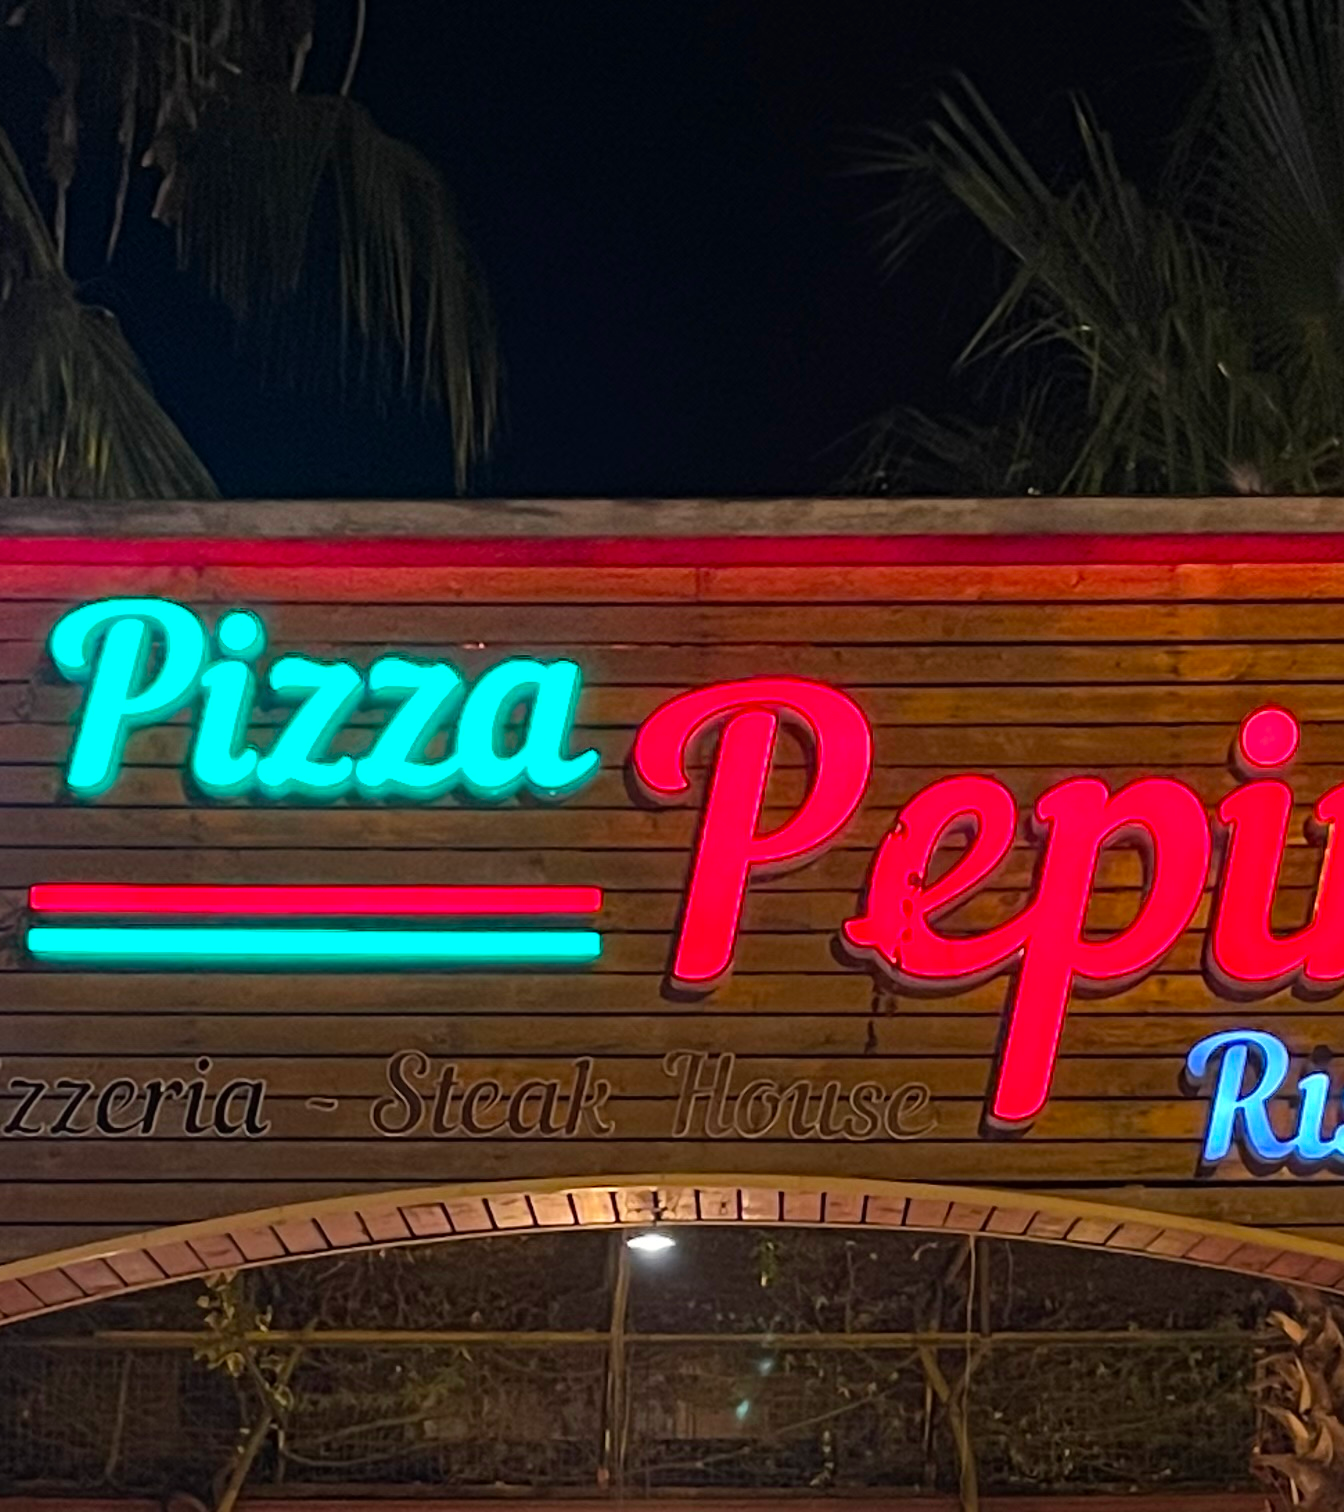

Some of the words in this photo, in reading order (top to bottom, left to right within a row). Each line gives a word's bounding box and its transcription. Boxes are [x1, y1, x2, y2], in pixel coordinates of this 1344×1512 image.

[48, 597, 601, 798] Pizza
[370, 1049, 615, 1138] Steak
[662, 1051, 939, 1140] House
